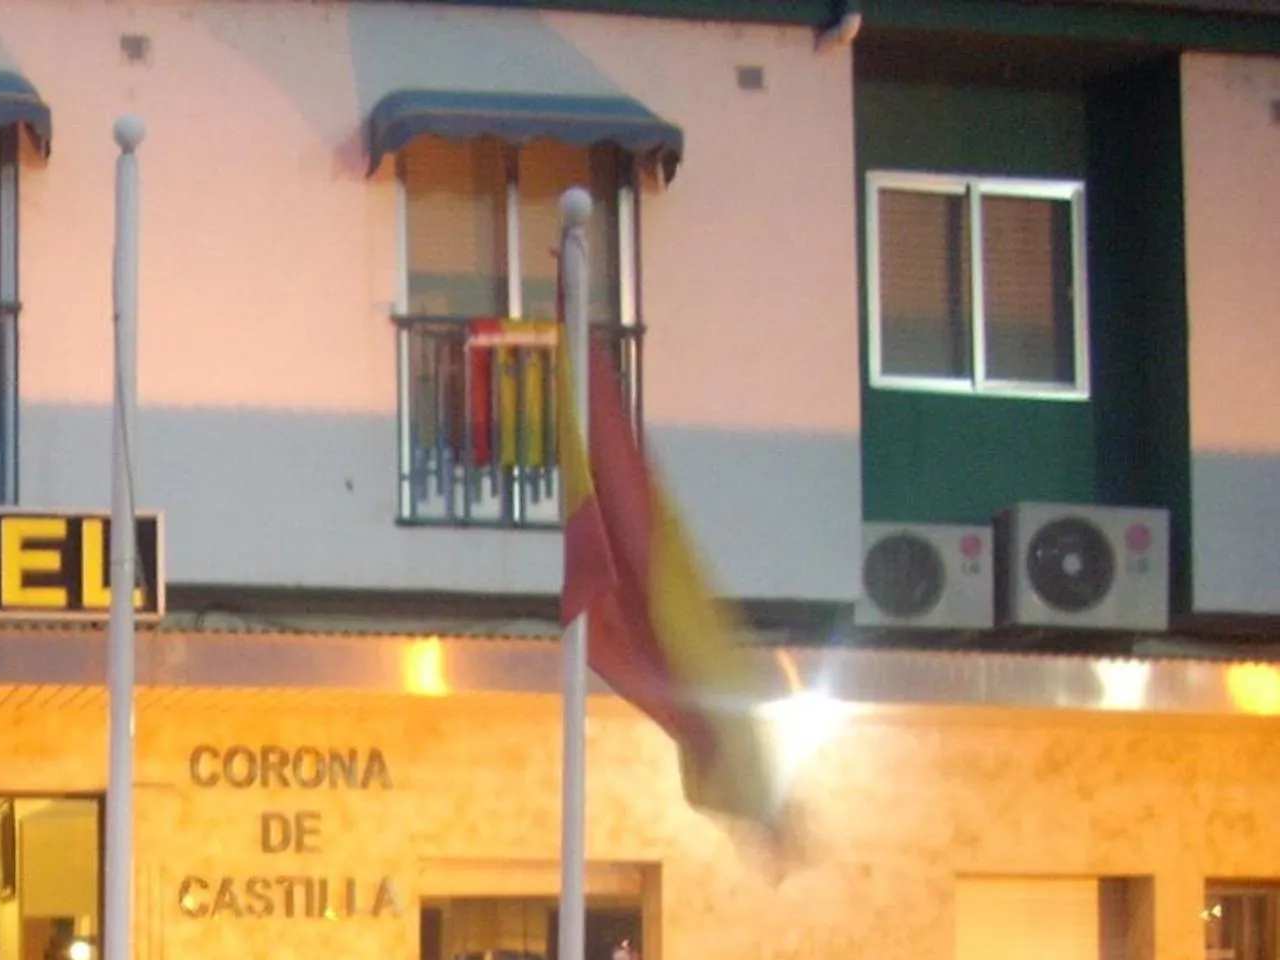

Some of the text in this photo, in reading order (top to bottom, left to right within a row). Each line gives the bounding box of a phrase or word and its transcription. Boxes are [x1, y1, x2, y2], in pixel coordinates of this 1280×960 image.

[189, 744, 393, 790] CORONA
[260, 810, 322, 853] DE
[178, 874, 402, 918] CASTILLA
